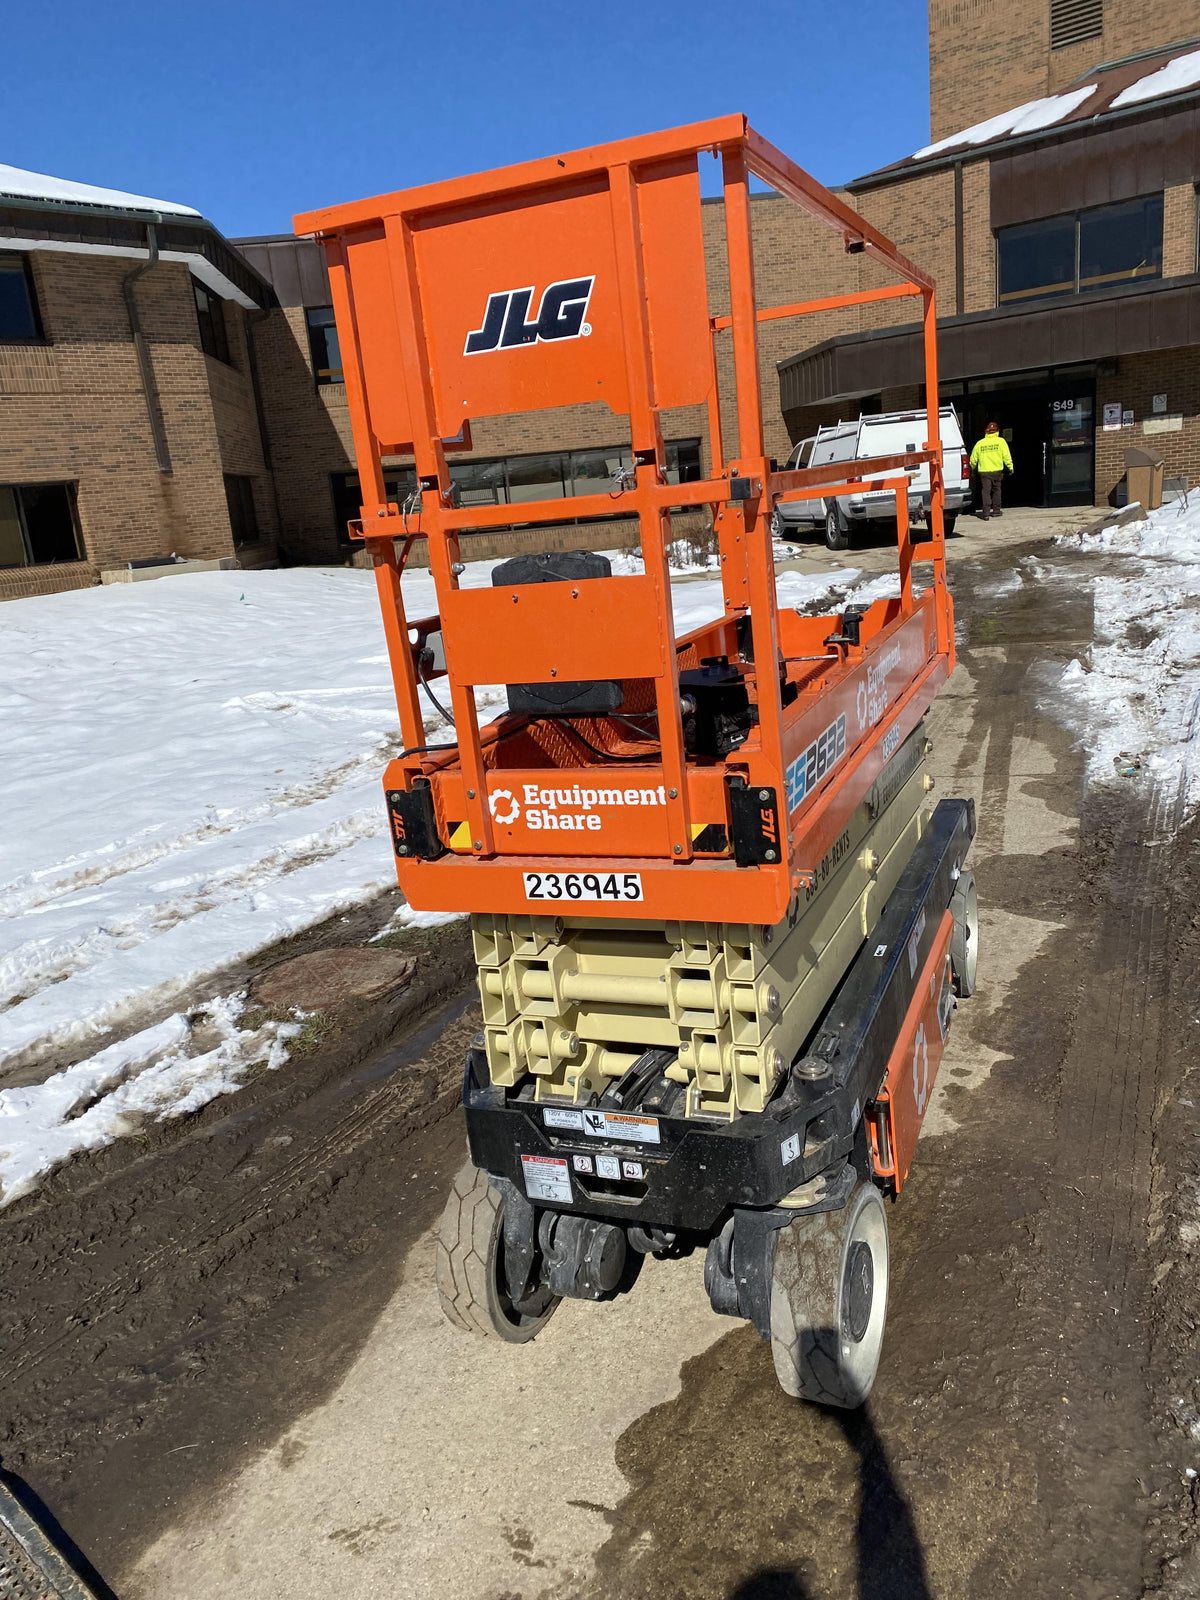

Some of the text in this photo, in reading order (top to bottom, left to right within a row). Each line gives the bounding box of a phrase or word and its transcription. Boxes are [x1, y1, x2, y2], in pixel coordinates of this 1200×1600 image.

[1053, 399, 1074, 411] S49
[868, 690, 888, 727] Share
[786, 711, 846, 815] ES2632
[522, 784, 667, 810] Equipment
[392, 808, 406, 840] JLG
[525, 809, 602, 830] Share
[761, 808, 776, 843] JLG
[526, 873, 641, 900] 236945
[619, 1115, 649, 1124] WARNING
